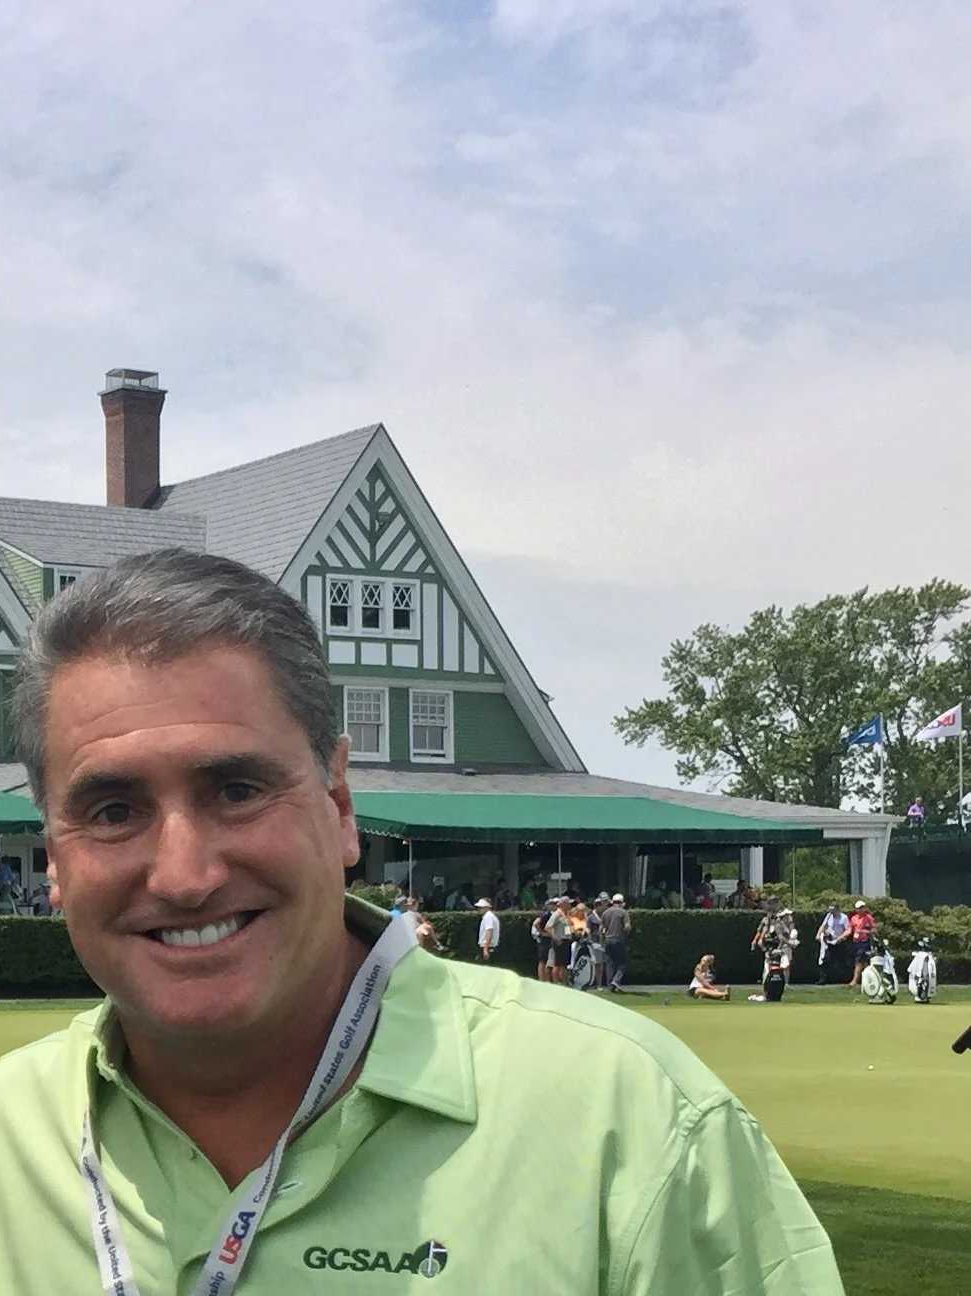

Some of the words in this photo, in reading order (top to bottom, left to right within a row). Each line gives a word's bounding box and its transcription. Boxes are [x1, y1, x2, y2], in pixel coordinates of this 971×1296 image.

[323, 1052, 344, 1085] States
[339, 1025, 356, 1050] Golf
[350, 963, 381, 1027] Association
[98, 1211, 108, 1226] by
[101, 1225, 112, 1246] the
[218, 1210, 256, 1265] USGA
[108, 1245, 121, 1281] United
[303, 1245, 419, 1275] GCSAA
